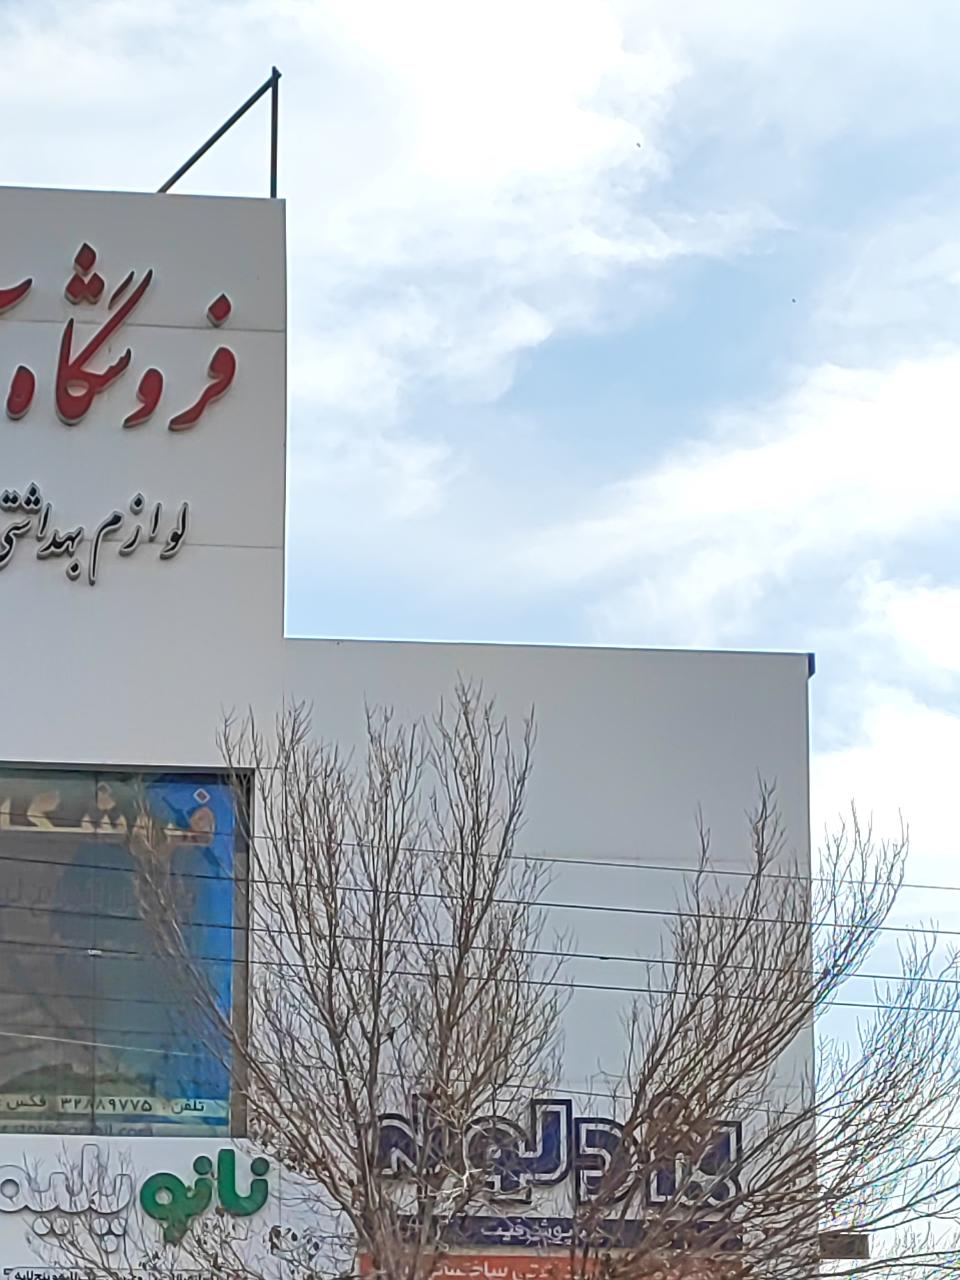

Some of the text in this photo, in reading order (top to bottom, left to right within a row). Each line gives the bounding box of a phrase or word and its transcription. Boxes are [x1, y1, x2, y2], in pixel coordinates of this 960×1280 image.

[6, 243, 237, 432] فروشگاه
[89, 493, 189, 586] لوازم
[140, 1148, 269, 1244] نانو
